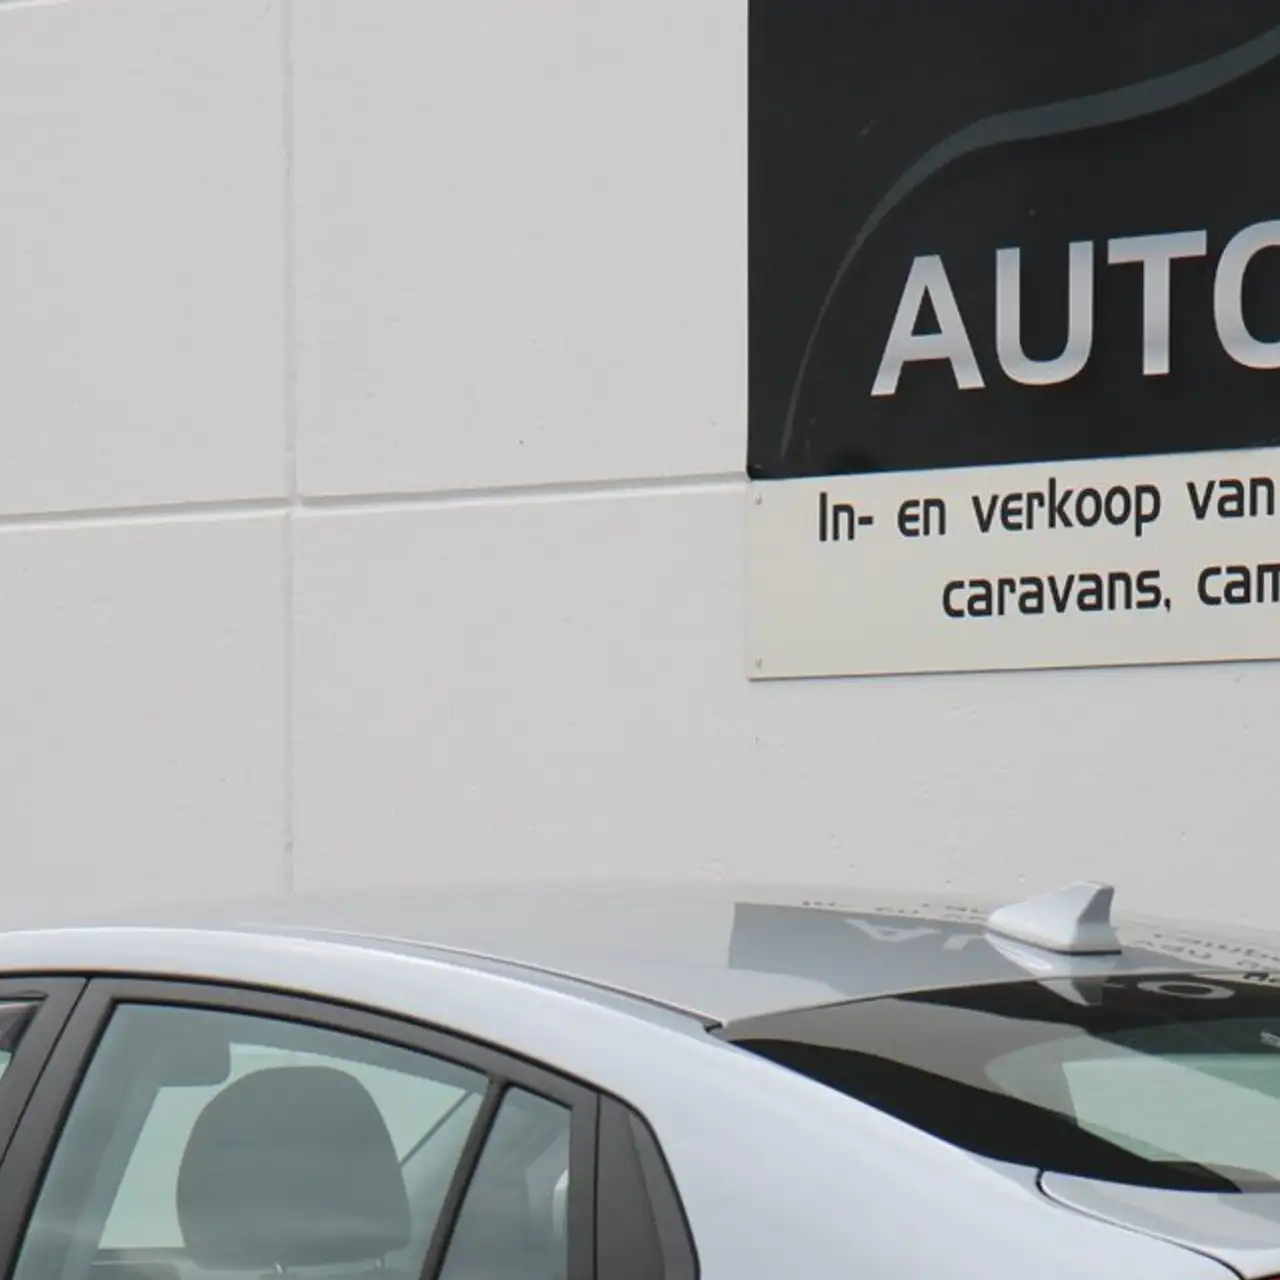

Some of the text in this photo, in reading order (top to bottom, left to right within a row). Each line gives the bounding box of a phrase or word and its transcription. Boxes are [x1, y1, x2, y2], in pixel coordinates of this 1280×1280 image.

[819, 492, 874, 542] In-
[897, 498, 946, 537] en
[972, 477, 1161, 537] verkoop
[1187, 477, 1275, 520] van
[942, 569, 1172, 618] caravans,
